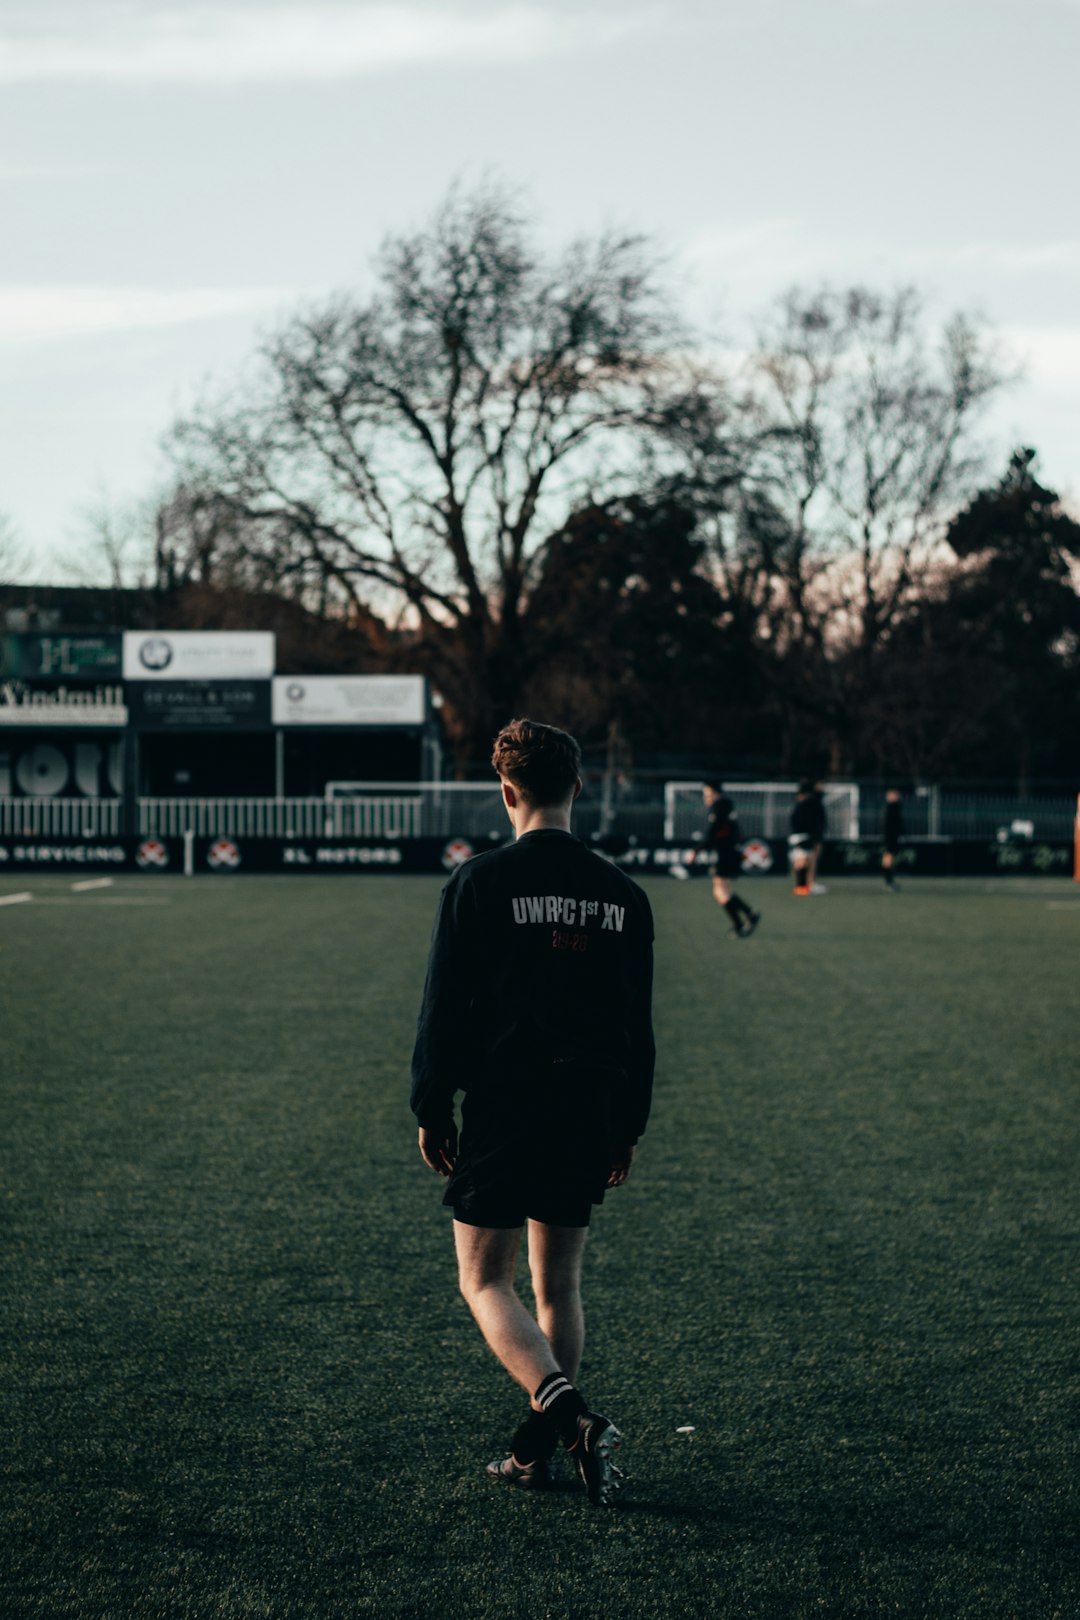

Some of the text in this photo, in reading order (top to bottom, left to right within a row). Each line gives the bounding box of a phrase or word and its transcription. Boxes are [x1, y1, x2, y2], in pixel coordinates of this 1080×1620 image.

[13, 845, 125, 862] SERVICING
[316, 847, 402, 864] MOTORS
[512, 896, 625, 932] UWRFC 1st XV
